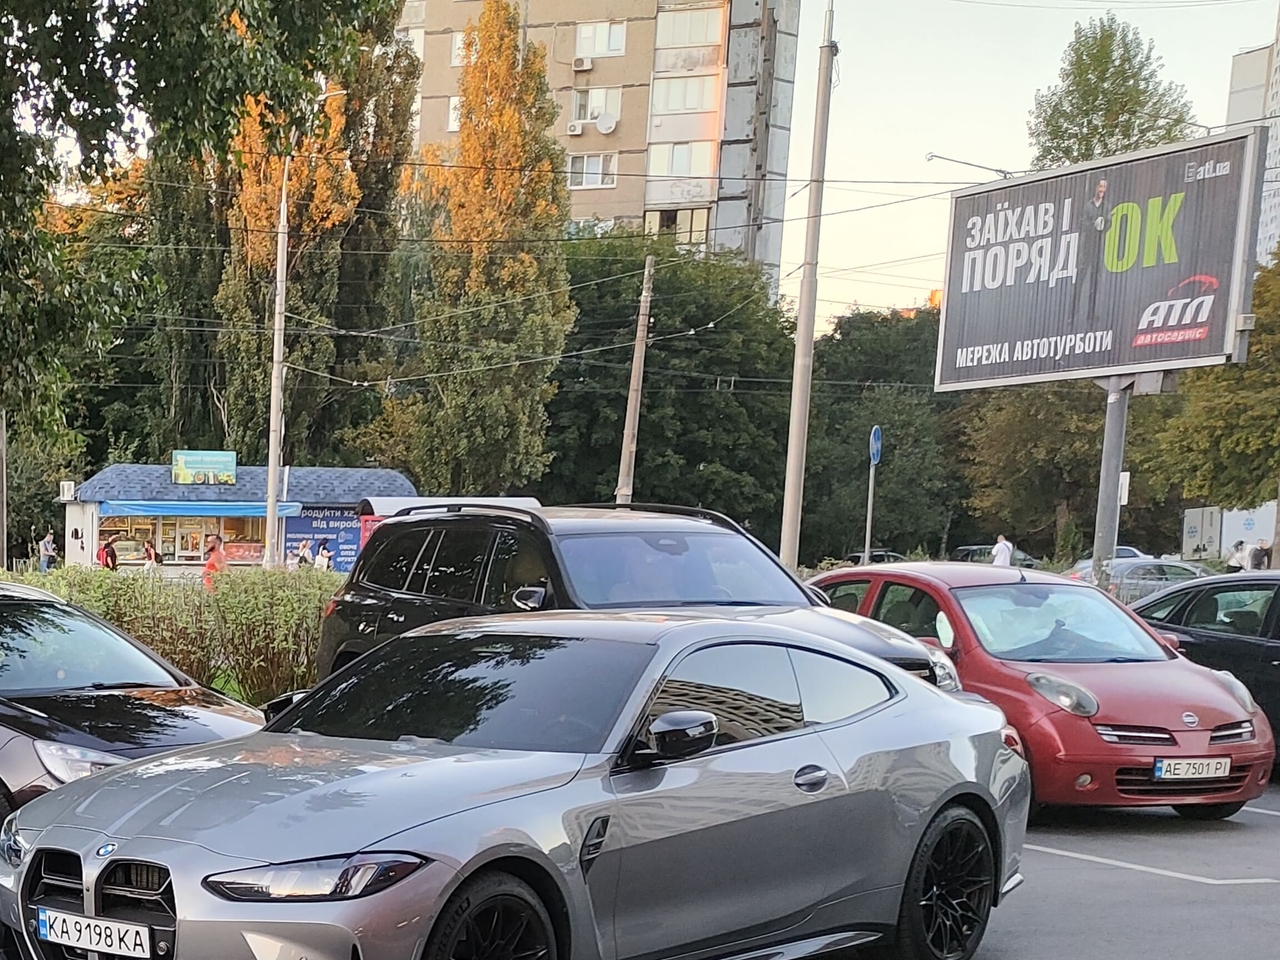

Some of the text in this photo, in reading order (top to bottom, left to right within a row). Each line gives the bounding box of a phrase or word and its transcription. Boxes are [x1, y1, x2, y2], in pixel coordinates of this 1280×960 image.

[965, 202, 1055, 249] ЗАЇХАВ
[1104, 192, 1186, 274] ОК
[961, 232, 1080, 294] ПОРЯД
[1138, 294, 1216, 330] АТЛ
[955, 330, 1114, 369] МЕРЕЖА АВТОТУРБОТИ
[1137, 329, 1204, 345] автосервіс
[301, 508, 341, 519] родукти
[1163, 762, 1182, 776] AE
[1184, 762, 1210, 776] 7501
[1214, 761, 1228, 774] PI
[47, 914, 146, 954] KA 9198 KA
